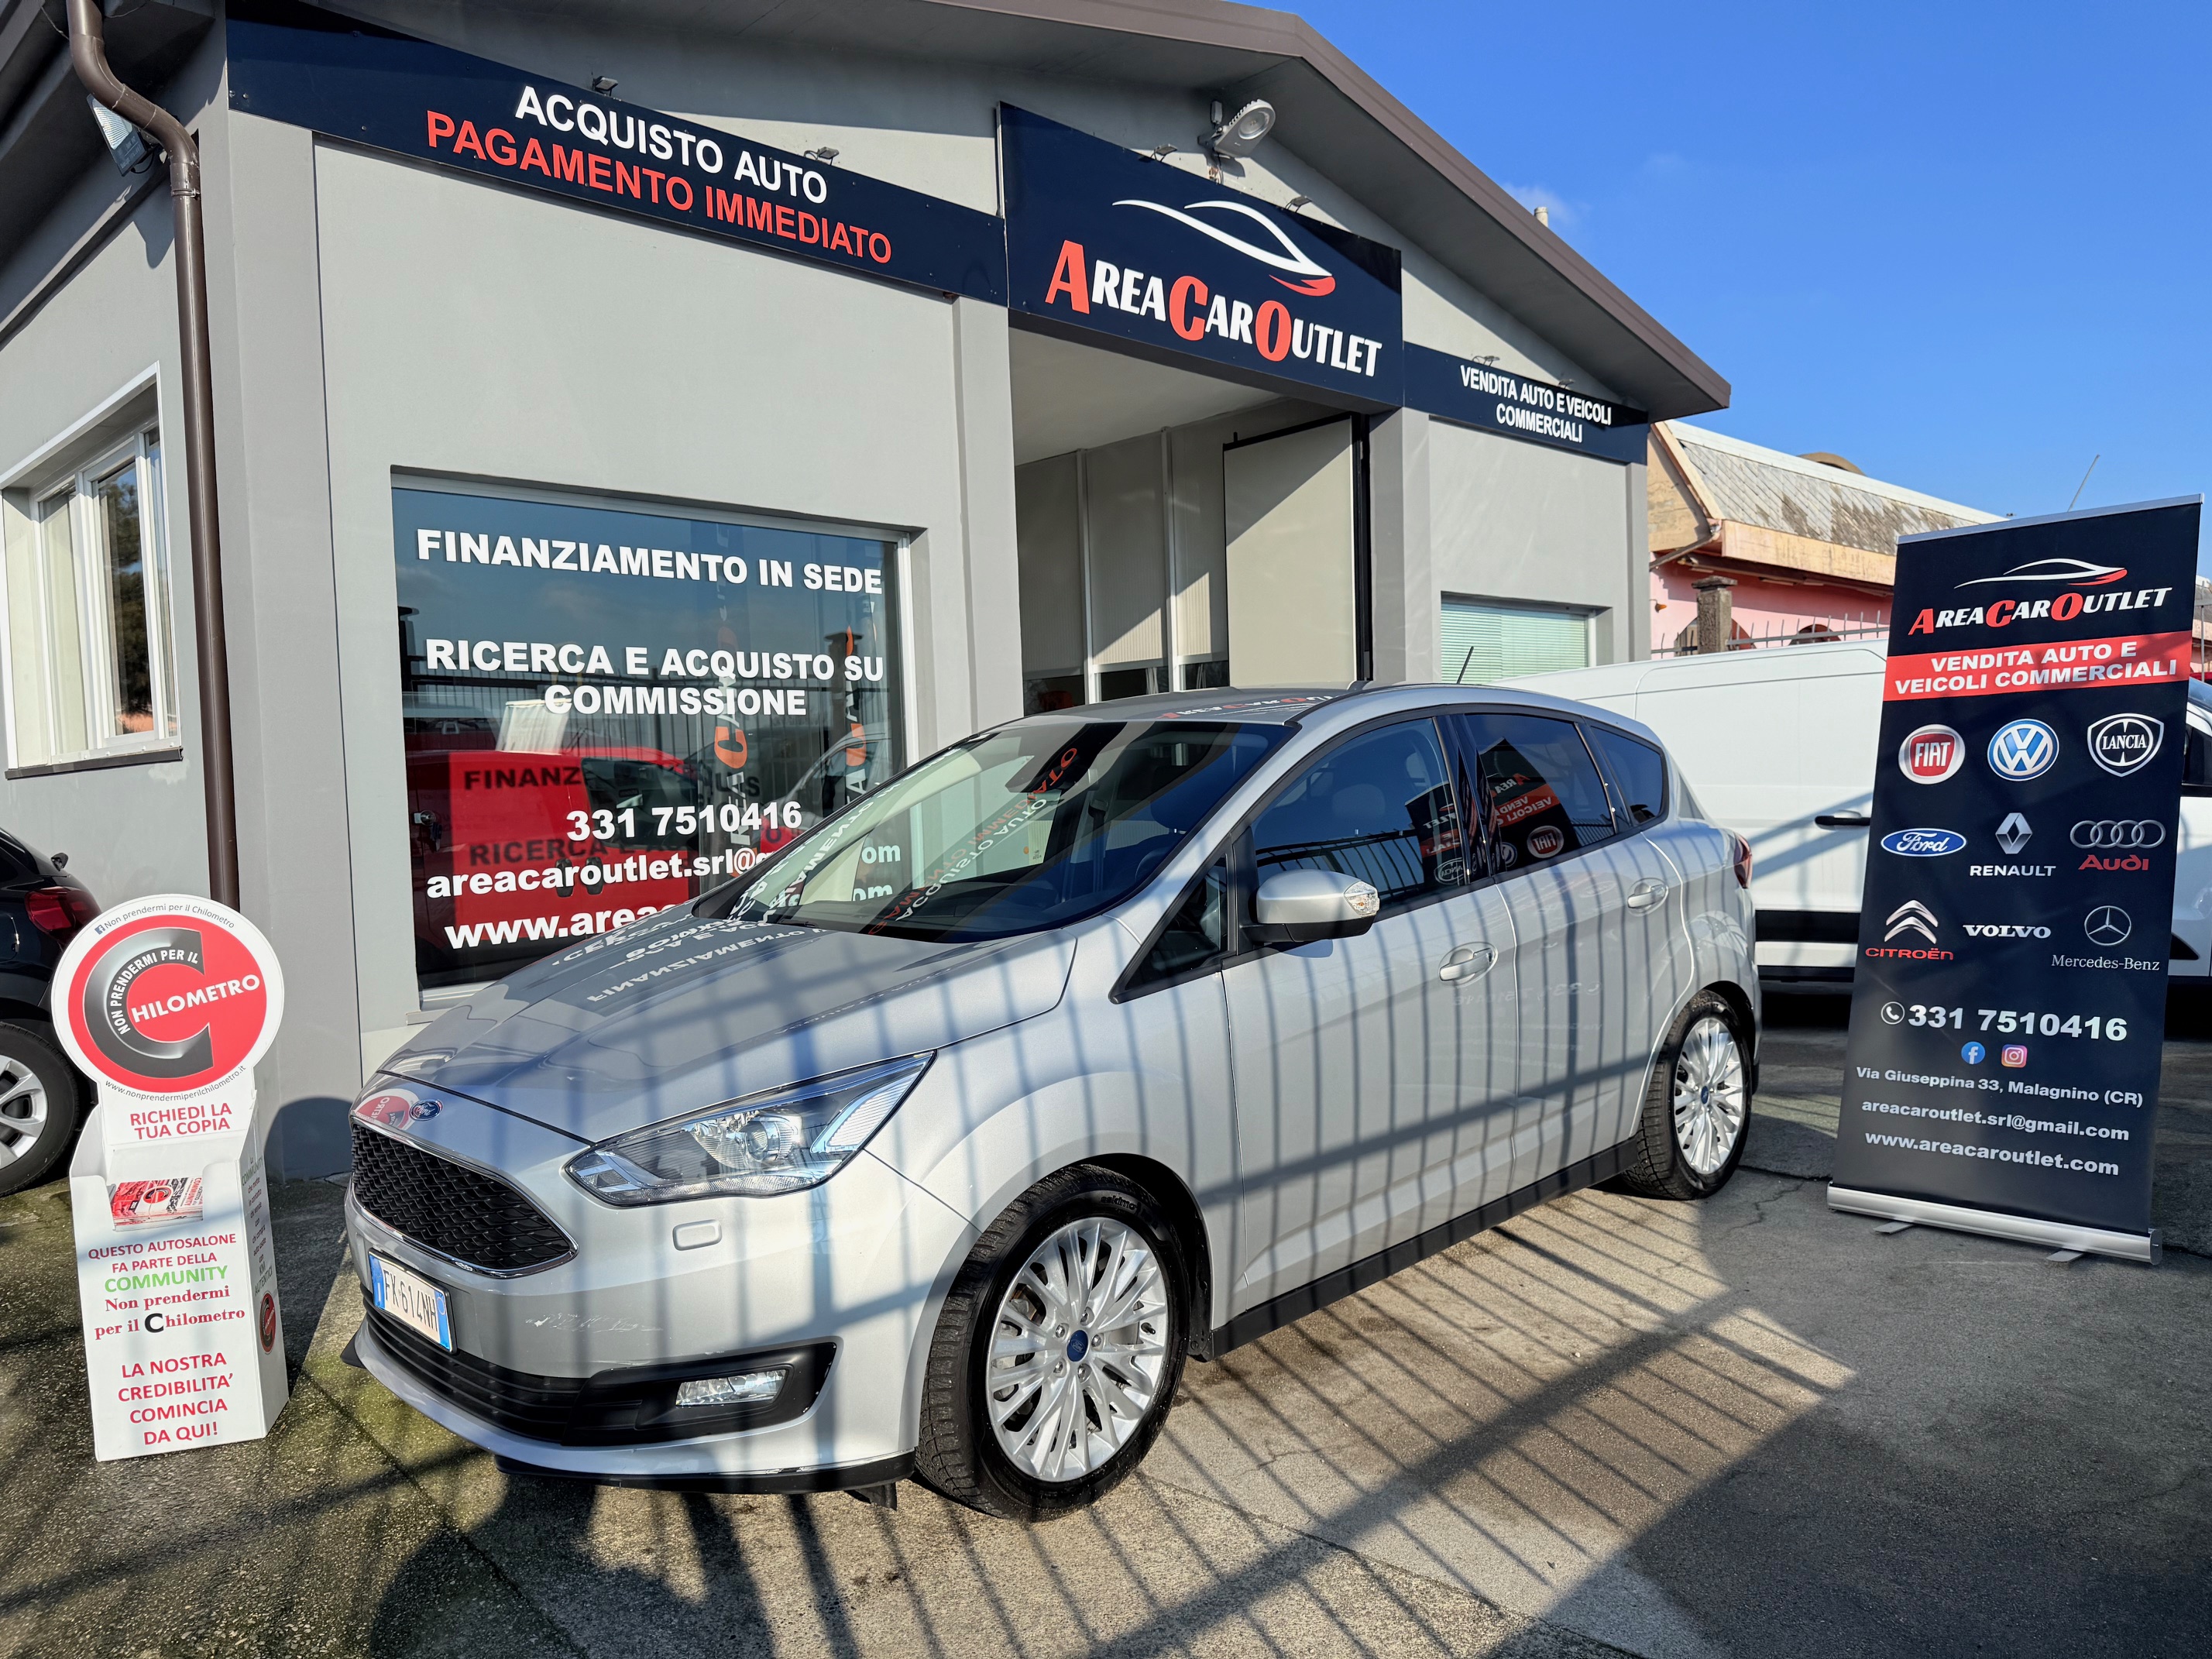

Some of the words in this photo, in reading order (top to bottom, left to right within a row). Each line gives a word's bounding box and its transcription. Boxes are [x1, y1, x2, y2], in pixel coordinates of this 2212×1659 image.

[515, 86, 723, 173] ACQUISTO
[733, 151, 826, 204] AUTO
[427, 111, 694, 211] PAGAMENTO
[705, 185, 891, 263] IMMEDIATO
[1461, 366, 1517, 401] VENDITA
[1520, 383, 1554, 411] AUTO
[1556, 392, 1565, 410] E
[1567, 396, 1612, 426] VEICOLI
[1496, 404, 1584, 442] COMMERCIALI
[417, 528, 747, 585] FINANZIAMENTO
[759, 559, 793, 588] IN
[802, 563, 883, 595] SEDE
[425, 638, 614, 675] RICERCA
[625, 647, 649, 676] E
[661, 648, 835, 682] ACQUISTO
[844, 654, 884, 682] SU
[1932, 650, 2034, 673] VENDITA
[2041, 644, 2111, 662] AUTO
[2121, 641, 2138, 658] E
[1895, 673, 1987, 695] VEICOLI
[1994, 659, 2176, 689] COMMERCIALI
[544, 684, 807, 716] COMMISSIONE
[1915, 740, 1951, 769] FIAT
[2101, 733, 2148, 752] LANCIA
[566, 809, 637, 842] 331
[652, 801, 802, 836] 7510416
[1895, 831, 1949, 854] Ford
[1970, 864, 2056, 877] RENAULT
[2078, 854, 2149, 872] Audi
[104, 916, 120, 930] Non
[122, 903, 167, 922] prendermi
[168, 904, 183, 912] per
[191, 905, 235, 929] Chilometro
[1963, 923, 2052, 939] VOLVO
[160, 950, 184, 961] PER
[187, 951, 198, 964] IL
[2051, 954, 2160, 971] Mercedes-Benz
[110, 952, 158, 1007] PRENDERMI
[111, 1010, 131, 1035] NON
[1908, 1005, 1964, 1029] 331
[1977, 1009, 2128, 1042] 7510416
[105, 1064, 246, 1102] www.nonprendermiperilchilometro.it
[1856, 1066, 1879, 1080] Via
[1884, 1069, 1974, 1091] Giuseppina
[1977, 1077, 2004, 1094] 33,
[2008, 1080, 2099, 1103] Malagnino
[2104, 1090, 2143, 1108] (CR)
[129, 1105, 205, 1126] RICHIEDI
[211, 1102, 232, 1116] LA
[1861, 1099, 2130, 1141] areacaroutlet.srl@gmail.com
[134, 1125, 172, 1140] TUA
[176, 1118, 231, 1135] COPIA
[1865, 1132, 2119, 1176] www.areacaroutlet.com
[88, 1243, 144, 1260] QUESTO
[147, 1233, 237, 1253] AUTOSALONE
[112, 1262, 129, 1273] FA
[132, 1255, 173, 1271] PARTE
[177, 1252, 218, 1267] DELLA
[104, 1265, 228, 1293] COMMUNITY
[105, 1297, 138, 1311] Non
[143, 1285, 230, 1310] prendermi
[94, 1323, 123, 1340] per
[127, 1317, 140, 1333] il
[144, 1307, 246, 1334] Chilometro
[122, 1363, 145, 1379] LA
[149, 1352, 227, 1376] NOSTRA
[129, 1397, 228, 1424] COMINCIA
[143, 1431, 170, 1445] DA
[176, 1421, 218, 1444] QUI!
